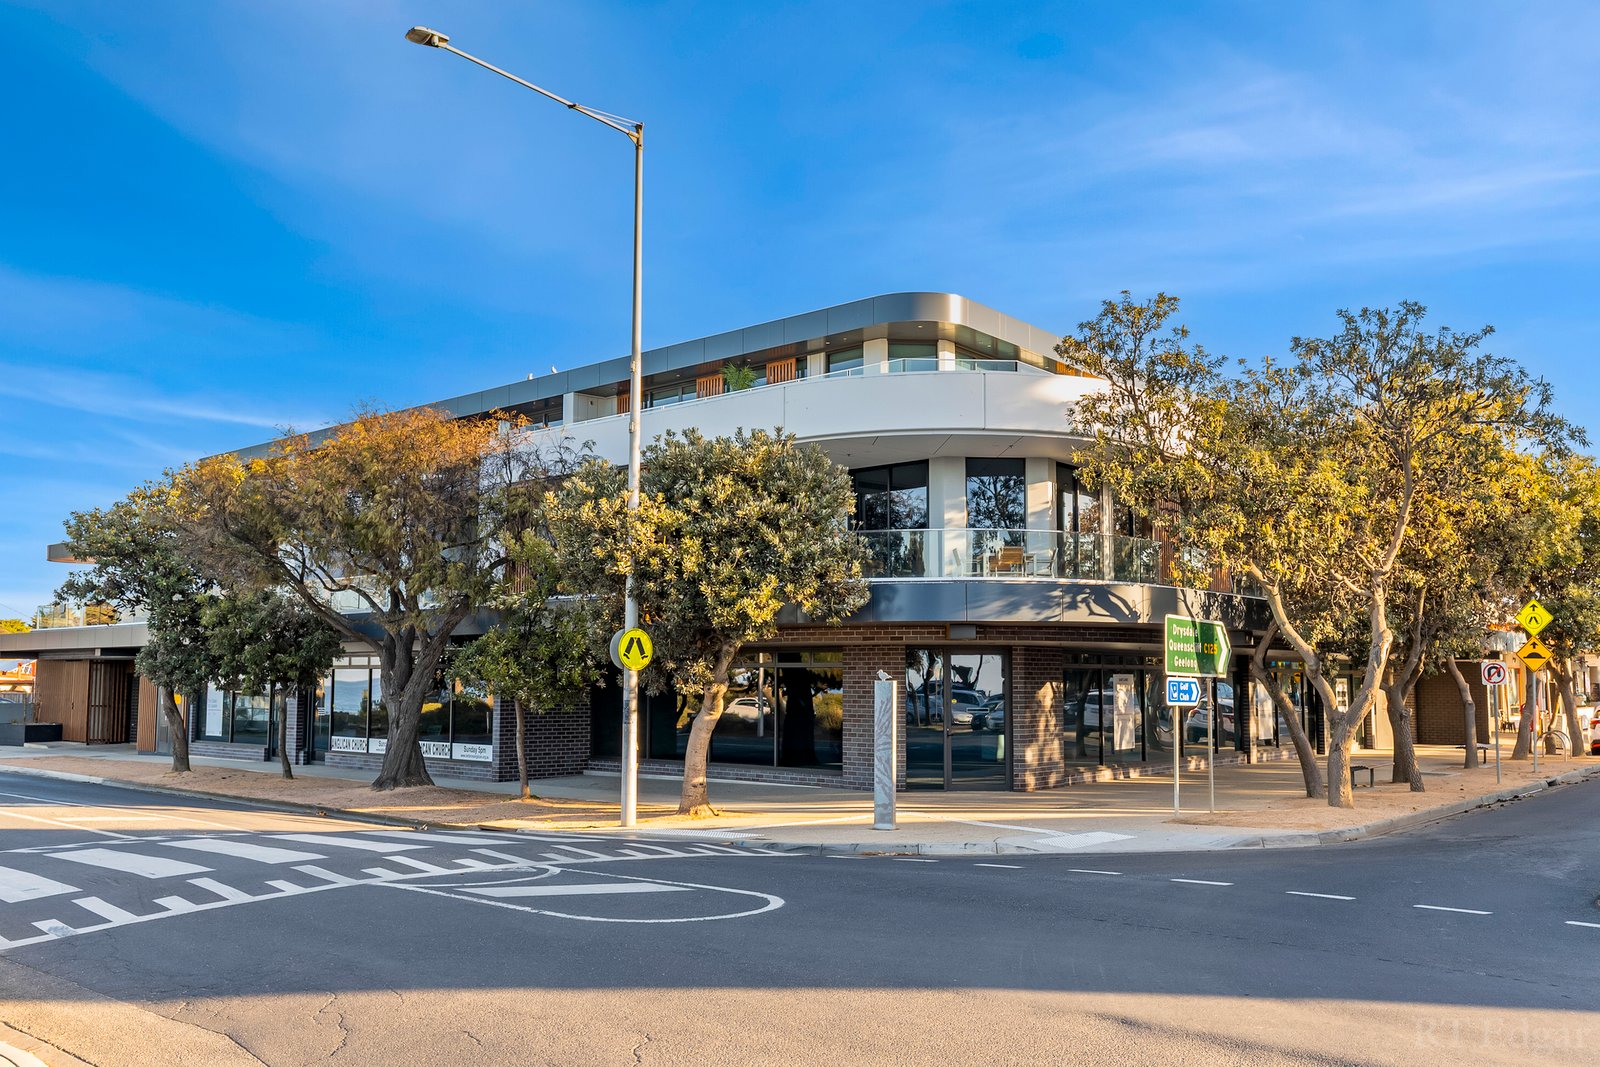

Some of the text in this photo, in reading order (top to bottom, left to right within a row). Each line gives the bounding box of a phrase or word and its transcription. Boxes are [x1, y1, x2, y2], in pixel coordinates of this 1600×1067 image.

[1173, 655, 1198, 671] Geelong
[463, 745, 487, 755] Sunday 5pm
